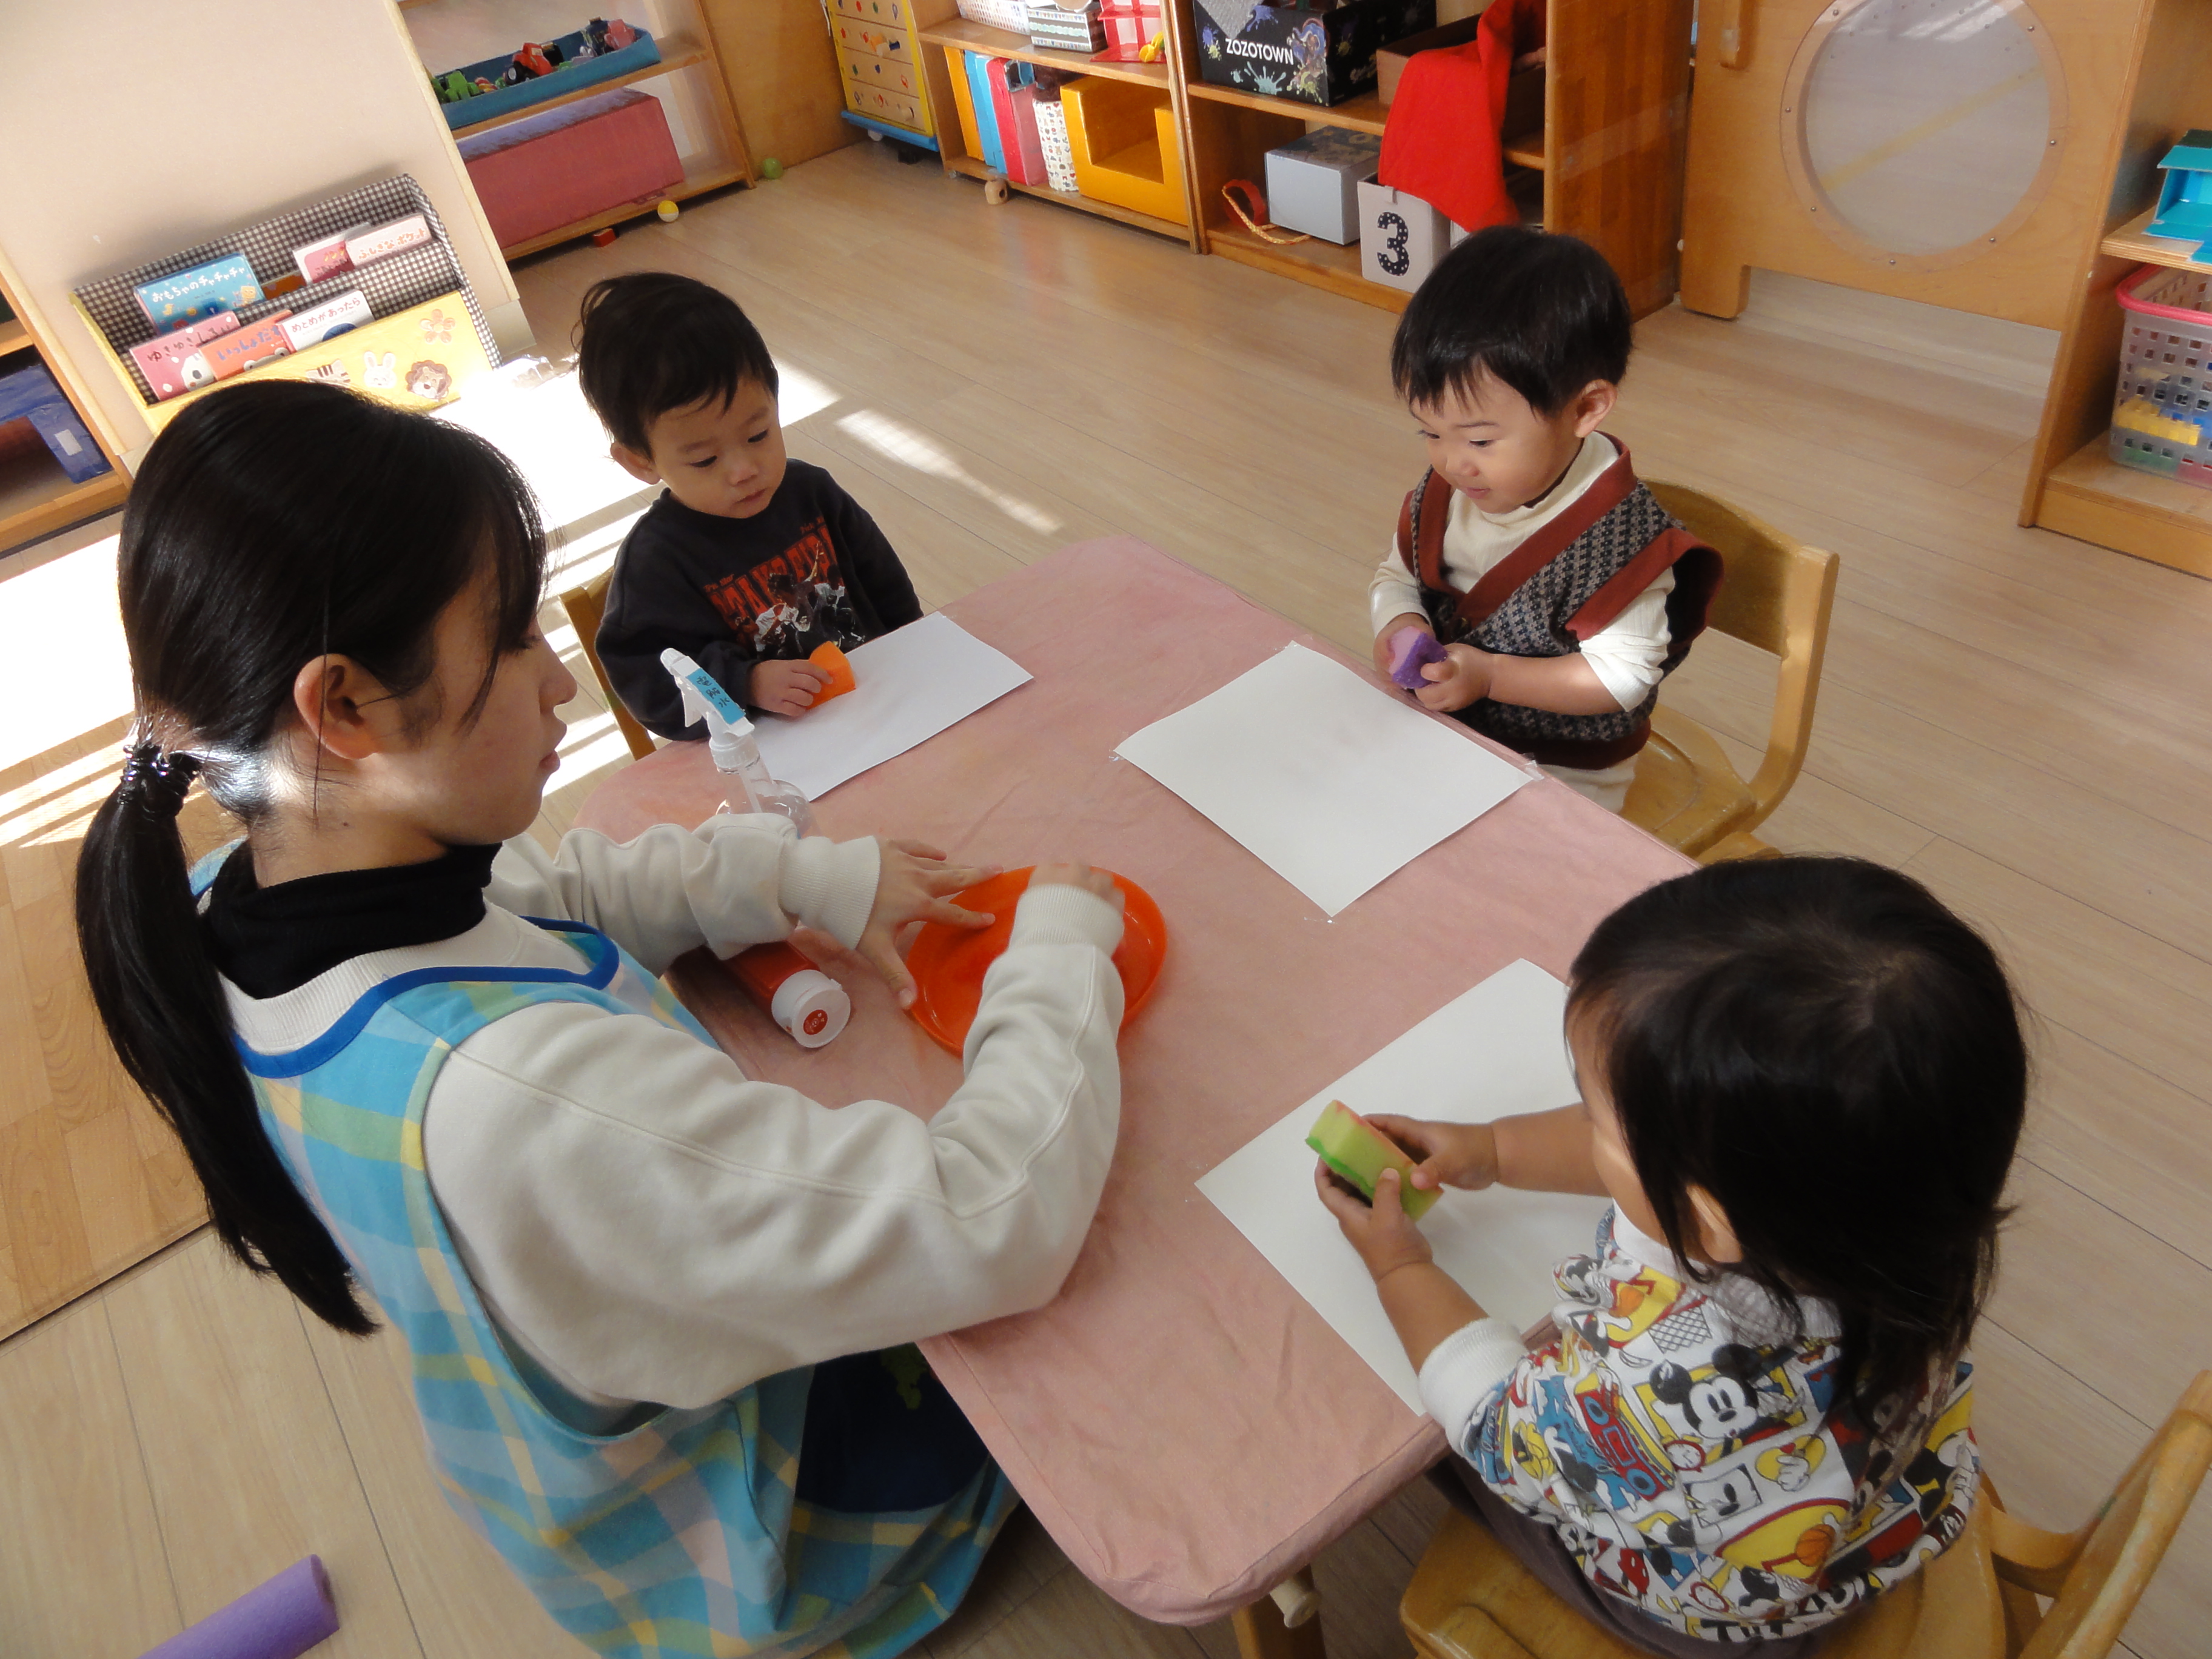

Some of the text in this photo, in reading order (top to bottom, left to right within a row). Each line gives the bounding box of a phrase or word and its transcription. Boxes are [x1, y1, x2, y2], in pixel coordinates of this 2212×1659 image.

[1225, 38, 1294, 65] ZOZOTOWN
[1377, 212, 1409, 276] 3
[152, 267, 245, 302] おもちゃのチャチャチャ
